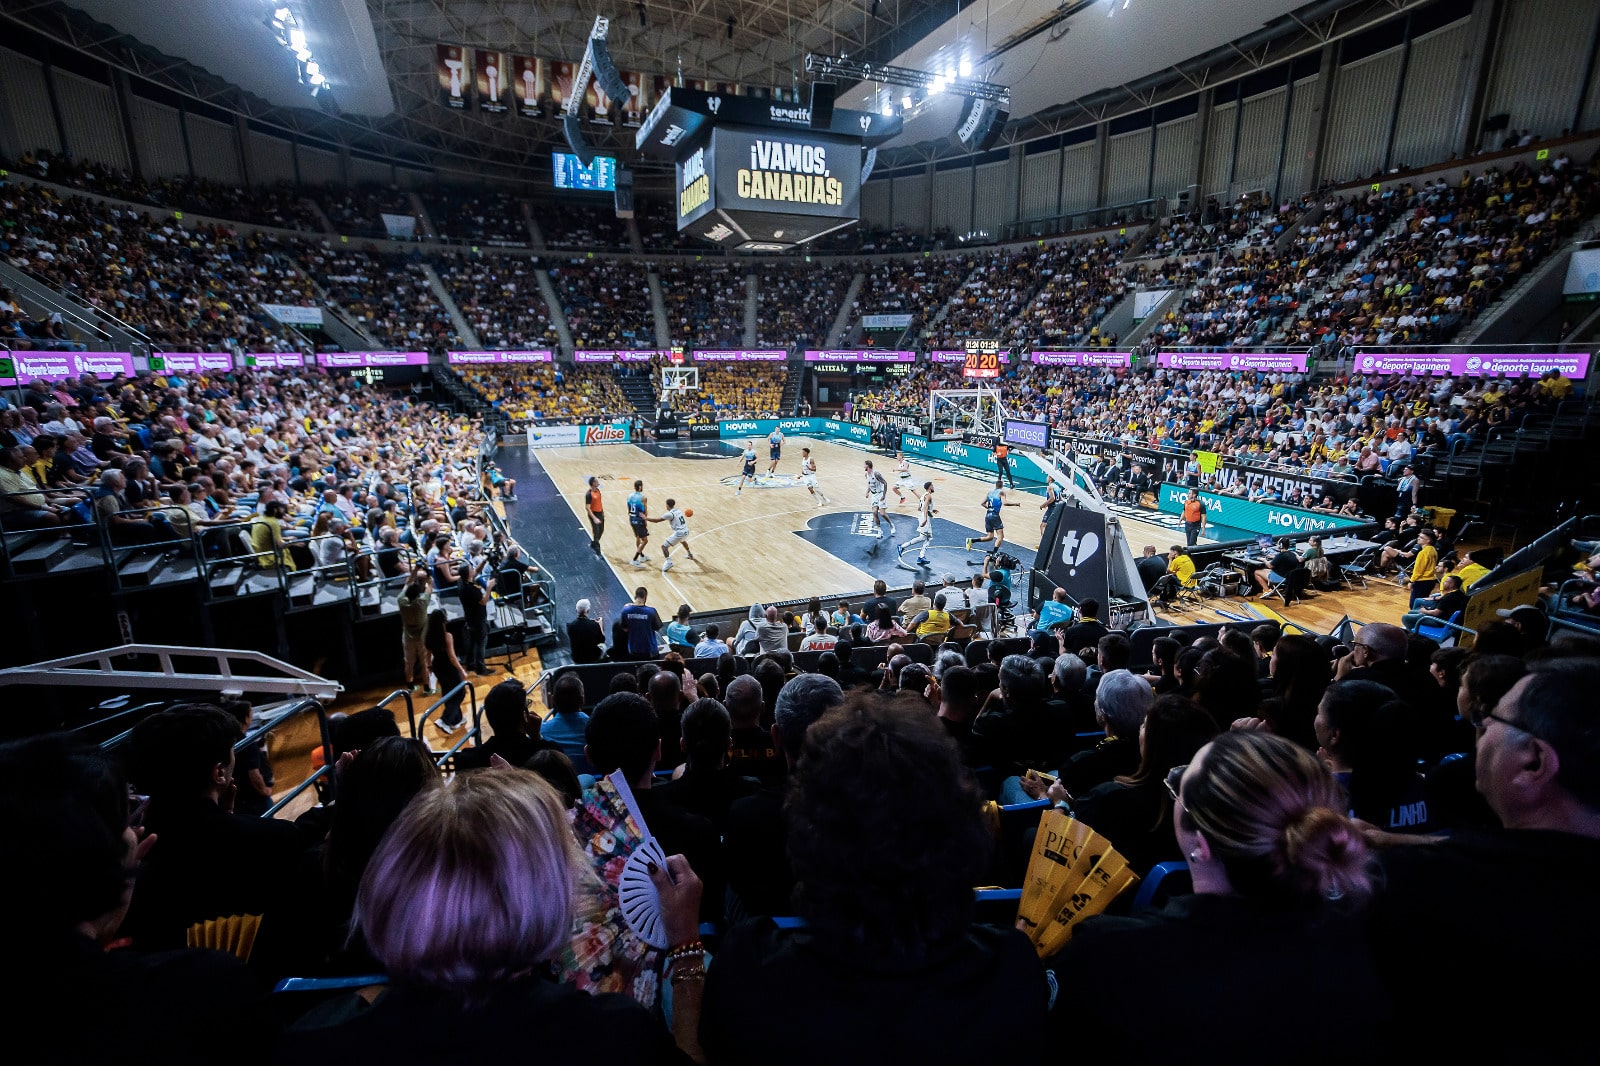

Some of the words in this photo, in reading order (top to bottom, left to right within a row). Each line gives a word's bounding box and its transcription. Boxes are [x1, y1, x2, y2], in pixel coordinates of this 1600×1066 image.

[751, 140, 830, 178] ¡VAMOS,
[737, 168, 842, 206] CANARIAS!
[966, 354, 977, 368] 20
[980, 354, 996, 368] 20
[1382, 362, 1413, 373] deporte
[1414, 362, 1450, 373] lagunero
[1492, 362, 1530, 374] deporte
[726, 422, 758, 430] HOVIMA
[780, 420, 810, 428] HOVIMA
[586, 426, 624, 443] Kalise
[850, 426, 868, 436] HOVIMA
[1007, 428, 1044, 442] endesa
[906, 437, 927, 448] HOVIMA
[970, 436, 992, 446] endesa
[943, 444, 968, 458] HOVIMA
[1078, 442, 1098, 454] DXT
[988, 454, 1018, 468] HOMA
